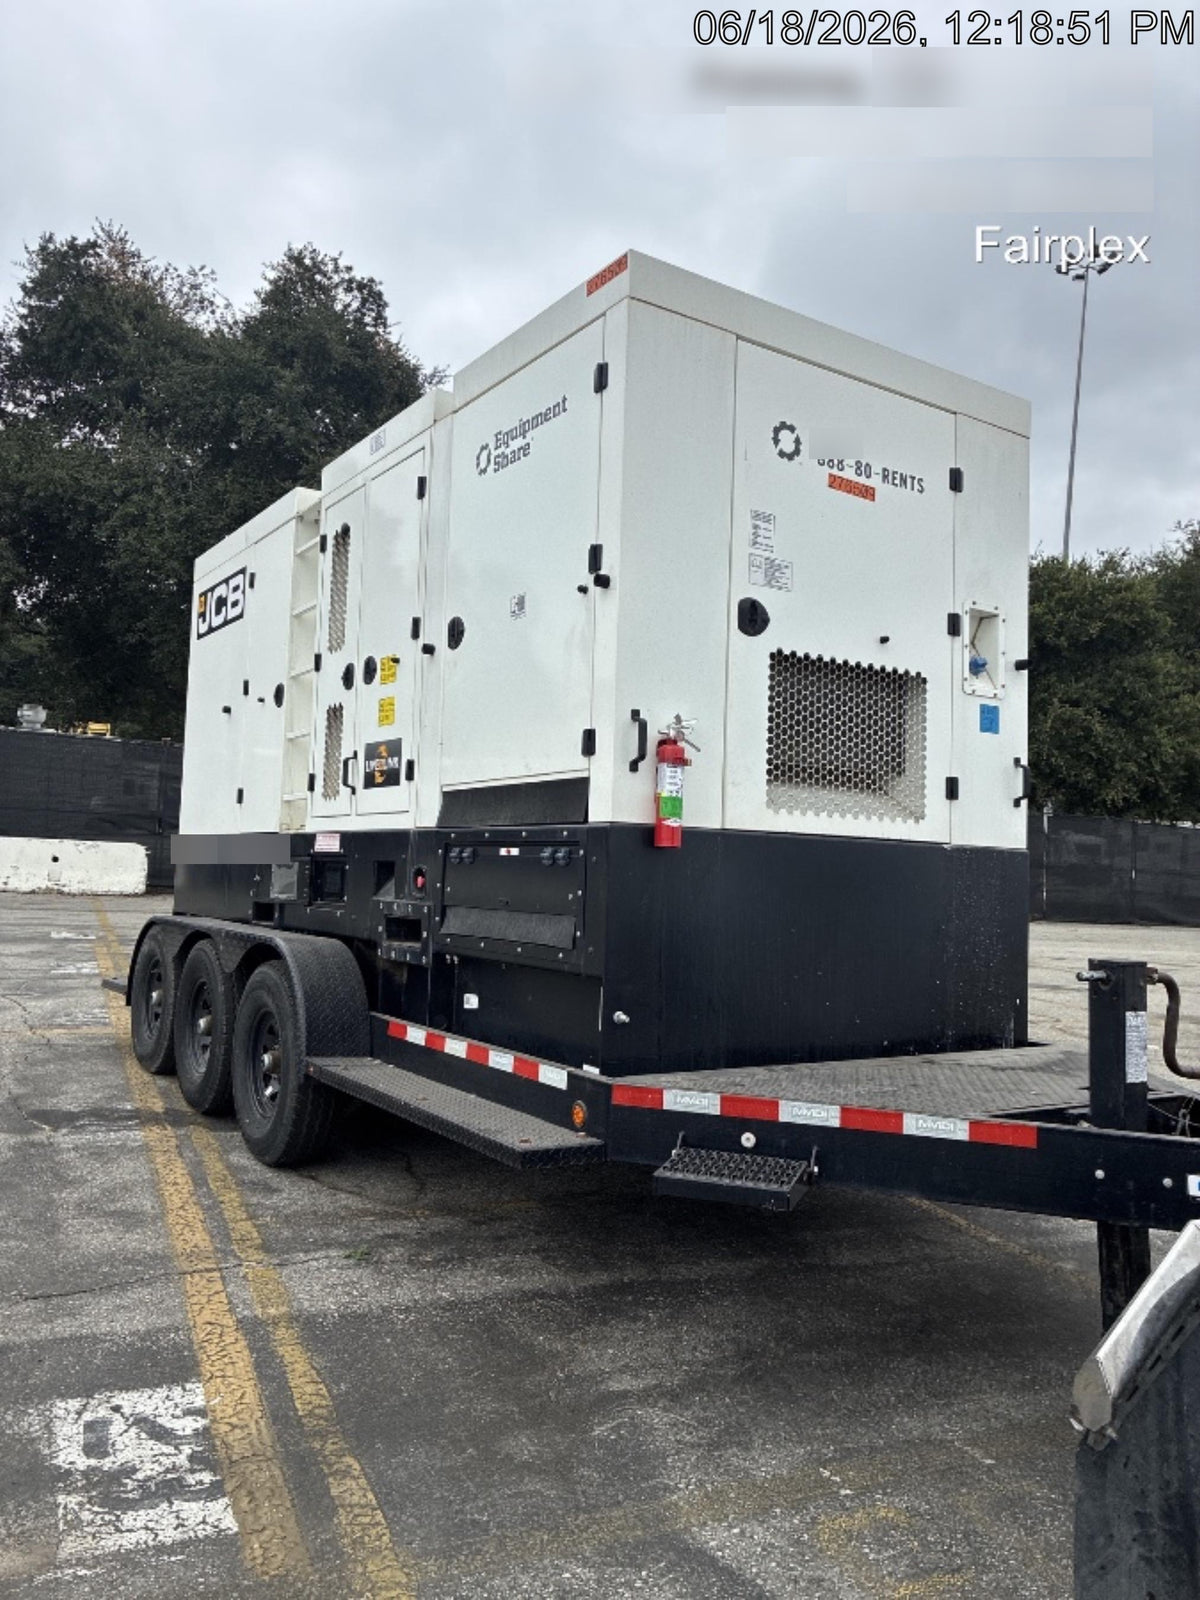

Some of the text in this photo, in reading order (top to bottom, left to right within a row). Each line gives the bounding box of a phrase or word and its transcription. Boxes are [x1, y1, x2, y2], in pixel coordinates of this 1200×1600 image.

[494, 395, 568, 450] Equipment
[493, 440, 531, 474] Share
[198, 572, 246, 635] JCB
